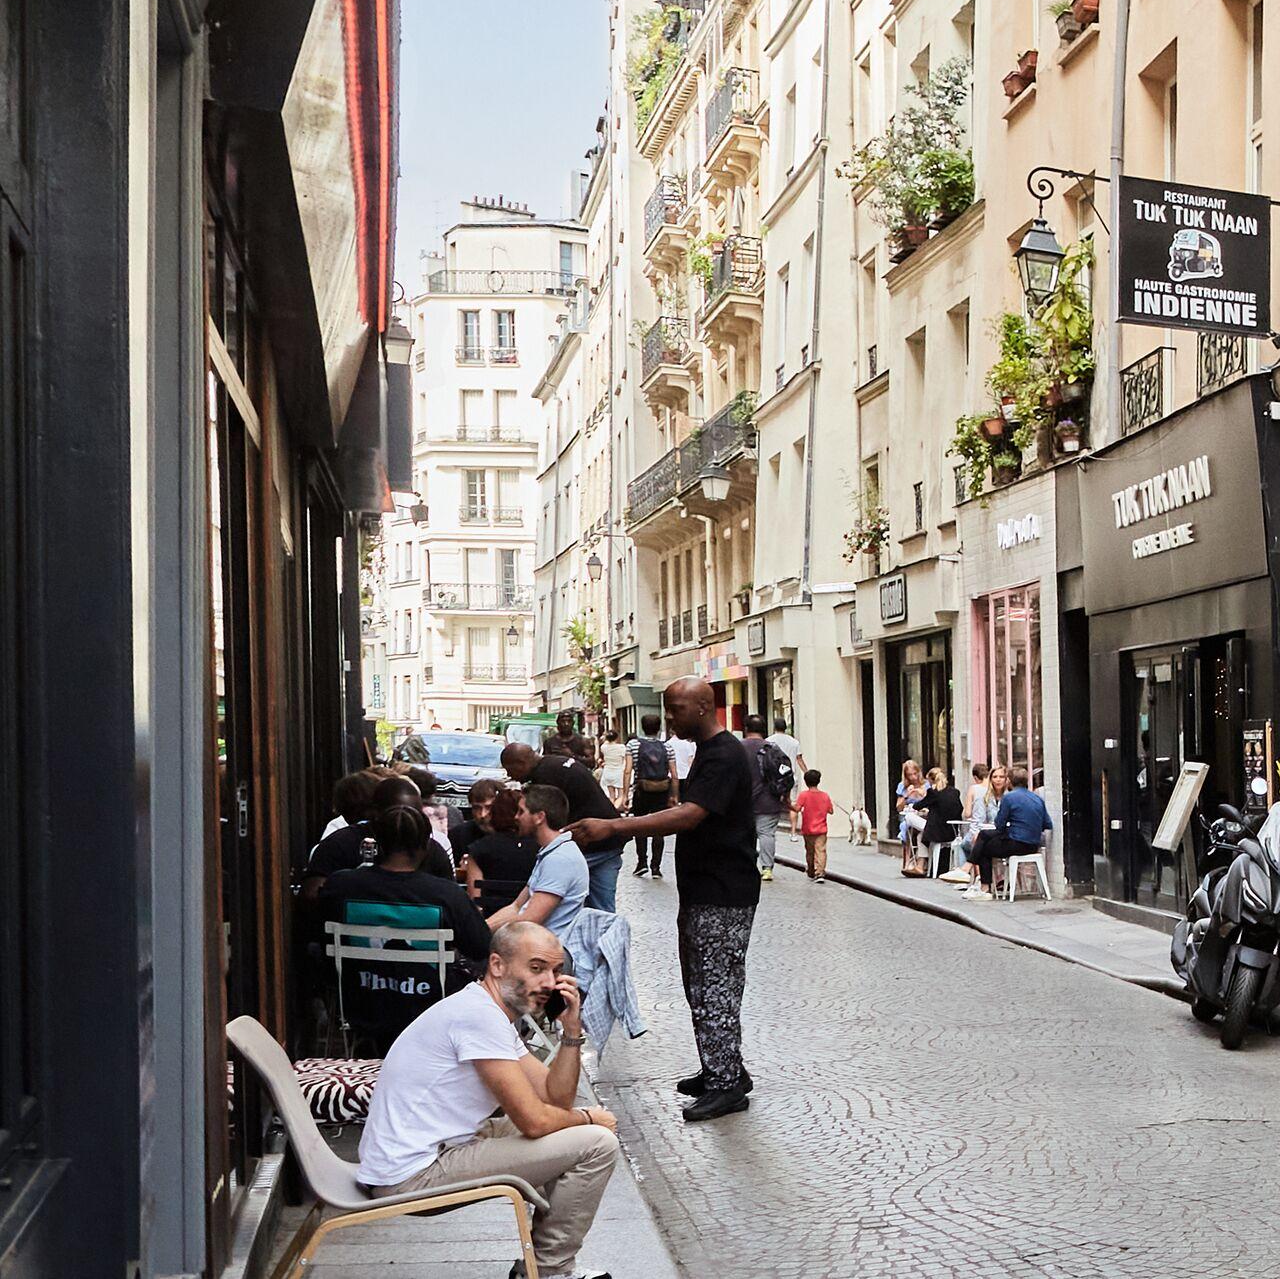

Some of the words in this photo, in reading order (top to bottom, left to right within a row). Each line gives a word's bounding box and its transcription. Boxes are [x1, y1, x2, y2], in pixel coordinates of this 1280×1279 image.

[1133, 199, 1167, 223] TUK
[1172, 205, 1206, 229] TUK
[1211, 214, 1258, 236] NAAN
[1164, 190, 1227, 211] RESTAURANT
[1134, 279, 1172, 294] HAUTE
[1175, 284, 1257, 304] GASTRONOMIE
[1134, 291, 1257, 327] INDIENNE
[1112, 484, 1141, 529] TUK
[1139, 473, 1170, 519] TUK
[1167, 455, 1211, 510] NAAN
